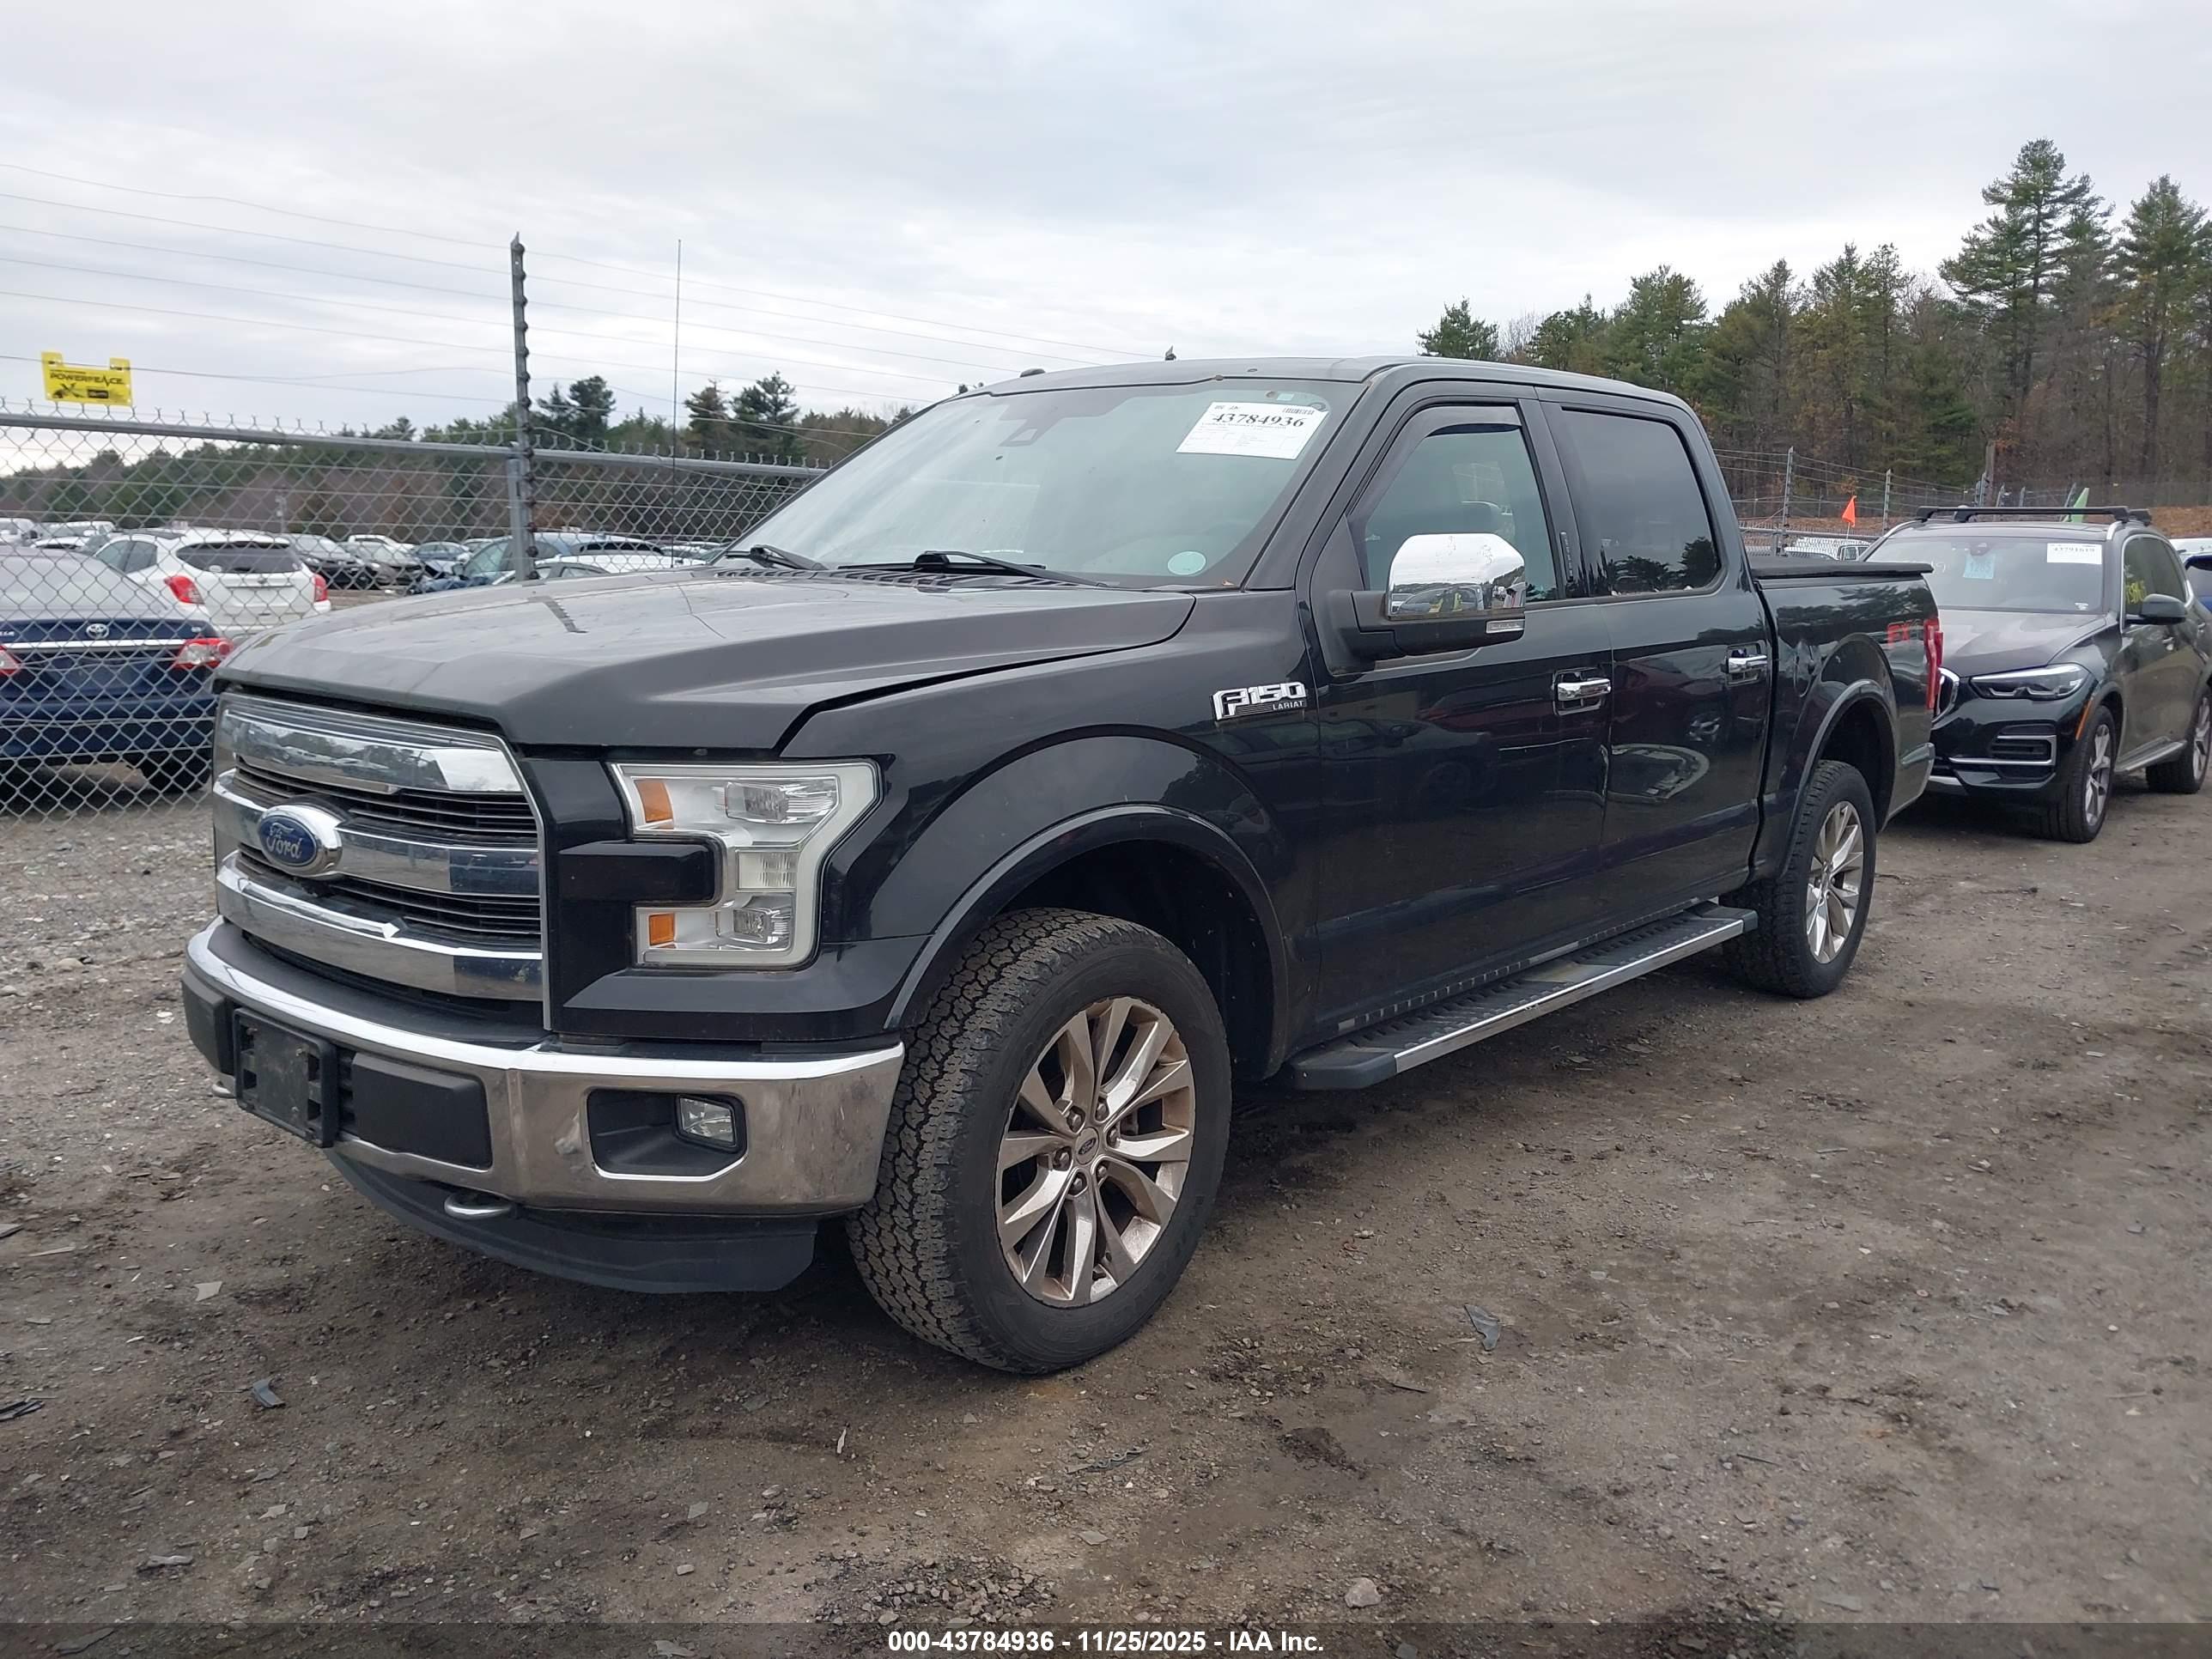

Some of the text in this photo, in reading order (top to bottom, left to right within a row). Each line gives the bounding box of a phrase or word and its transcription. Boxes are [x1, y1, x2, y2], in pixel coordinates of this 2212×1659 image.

[1212, 413, 1307, 428] 43784936
[1273, 700, 1304, 711] LARIAT
[266, 823, 303, 859] Ford
